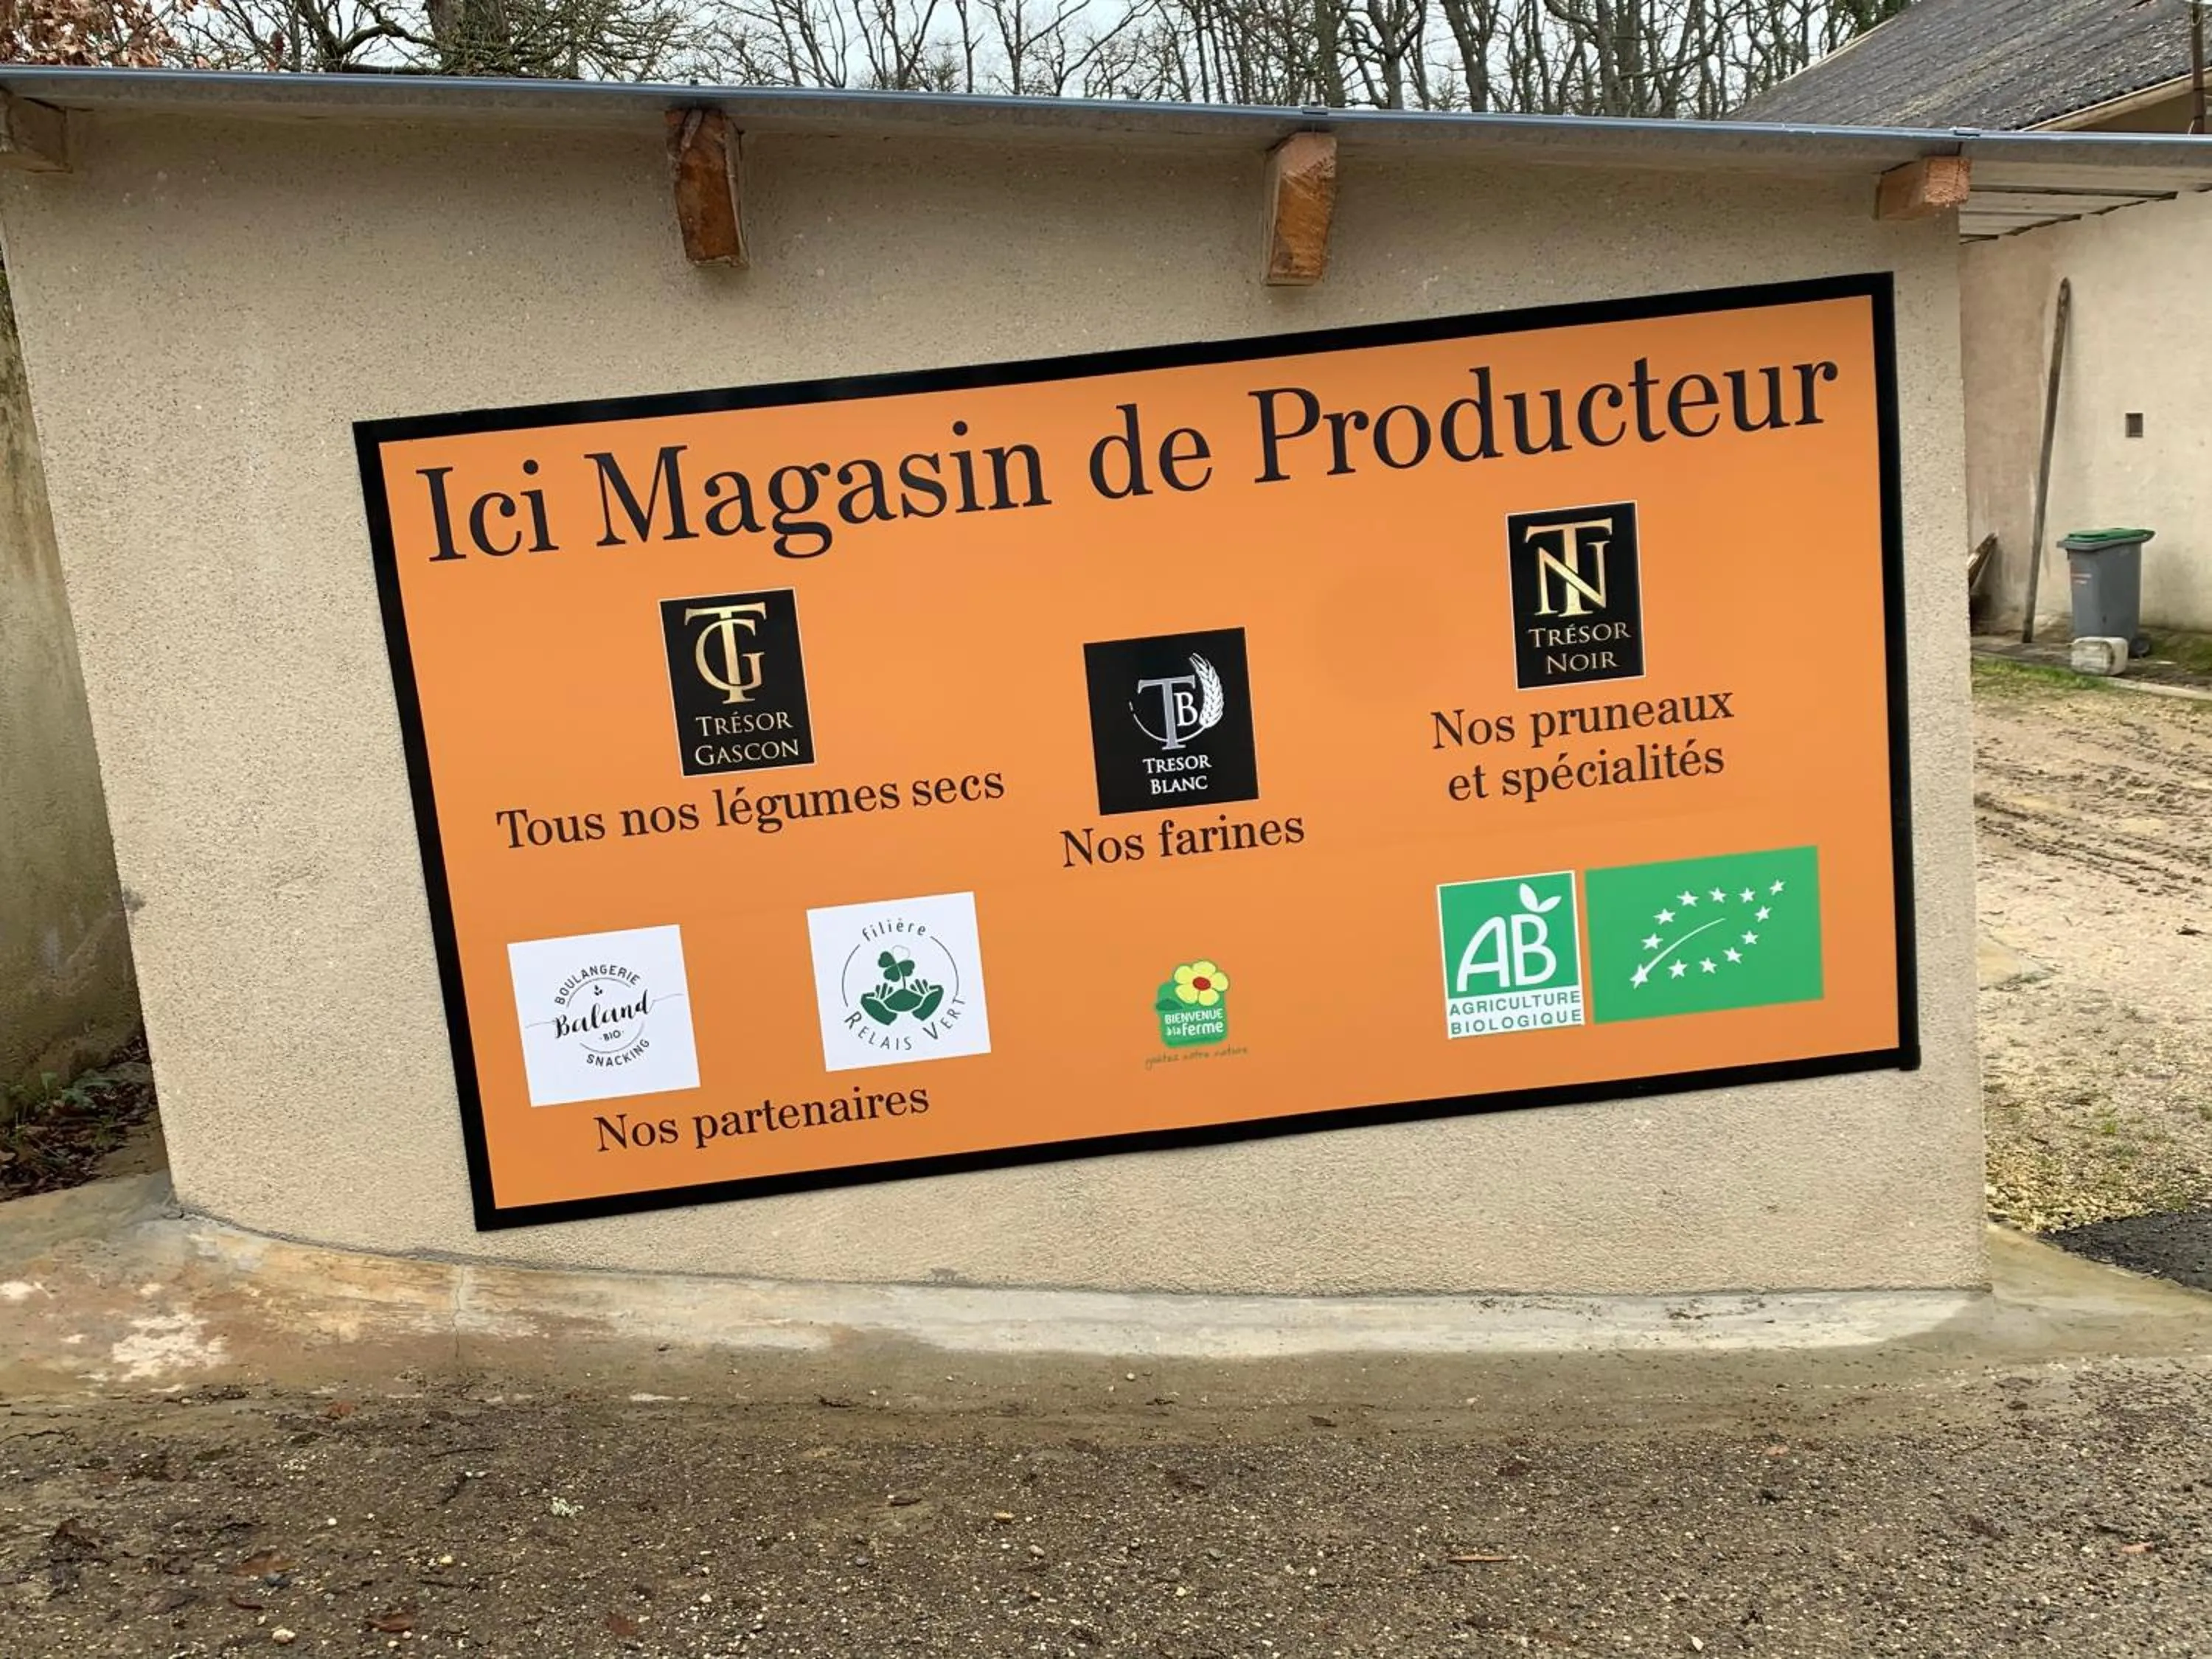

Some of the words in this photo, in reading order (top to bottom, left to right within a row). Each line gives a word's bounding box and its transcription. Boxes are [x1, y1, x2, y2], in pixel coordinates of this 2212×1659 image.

[416, 459, 559, 562] Ici
[584, 420, 1052, 559] Magasin
[1089, 403, 1213, 499] de
[1248, 357, 1838, 484] Producteur
[1528, 622, 1631, 648] TRÉSOR
[1545, 651, 1620, 674] NOIR
[695, 712, 793, 737] TRÉSOR
[1432, 709, 1515, 749] Nos
[1531, 692, 1735, 748] pruneaux
[695, 739, 799, 766] GASCON
[1143, 754, 1212, 773] TRESOR
[1448, 765, 1486, 801] et
[1500, 739, 1725, 803] spécialités
[1150, 775, 1208, 795] BLANC
[495, 810, 606, 849] Tous
[620, 804, 700, 837] nos
[712, 783, 900, 834] légumes
[912, 771, 1005, 806] secs
[1060, 828, 1144, 868] Nos
[1158, 815, 1305, 857] farines
[862, 918, 926, 942] filière
[1456, 914, 1557, 992] AB
[554, 964, 640, 1005] BOULANGERIE
[1164, 1008, 1223, 1025] BIENVENUE
[1449, 991, 1581, 1016] AGRICULTURE
[844, 1011, 912, 1051] RELAIS
[922, 996, 965, 1040] VERT
[1182, 1021, 1224, 1036] ferme
[1451, 1009, 1582, 1035] BIOLOGIQUE
[586, 1038, 650, 1067] SNACKING
[594, 1113, 679, 1152] Nos
[692, 1086, 930, 1150] partenaires
